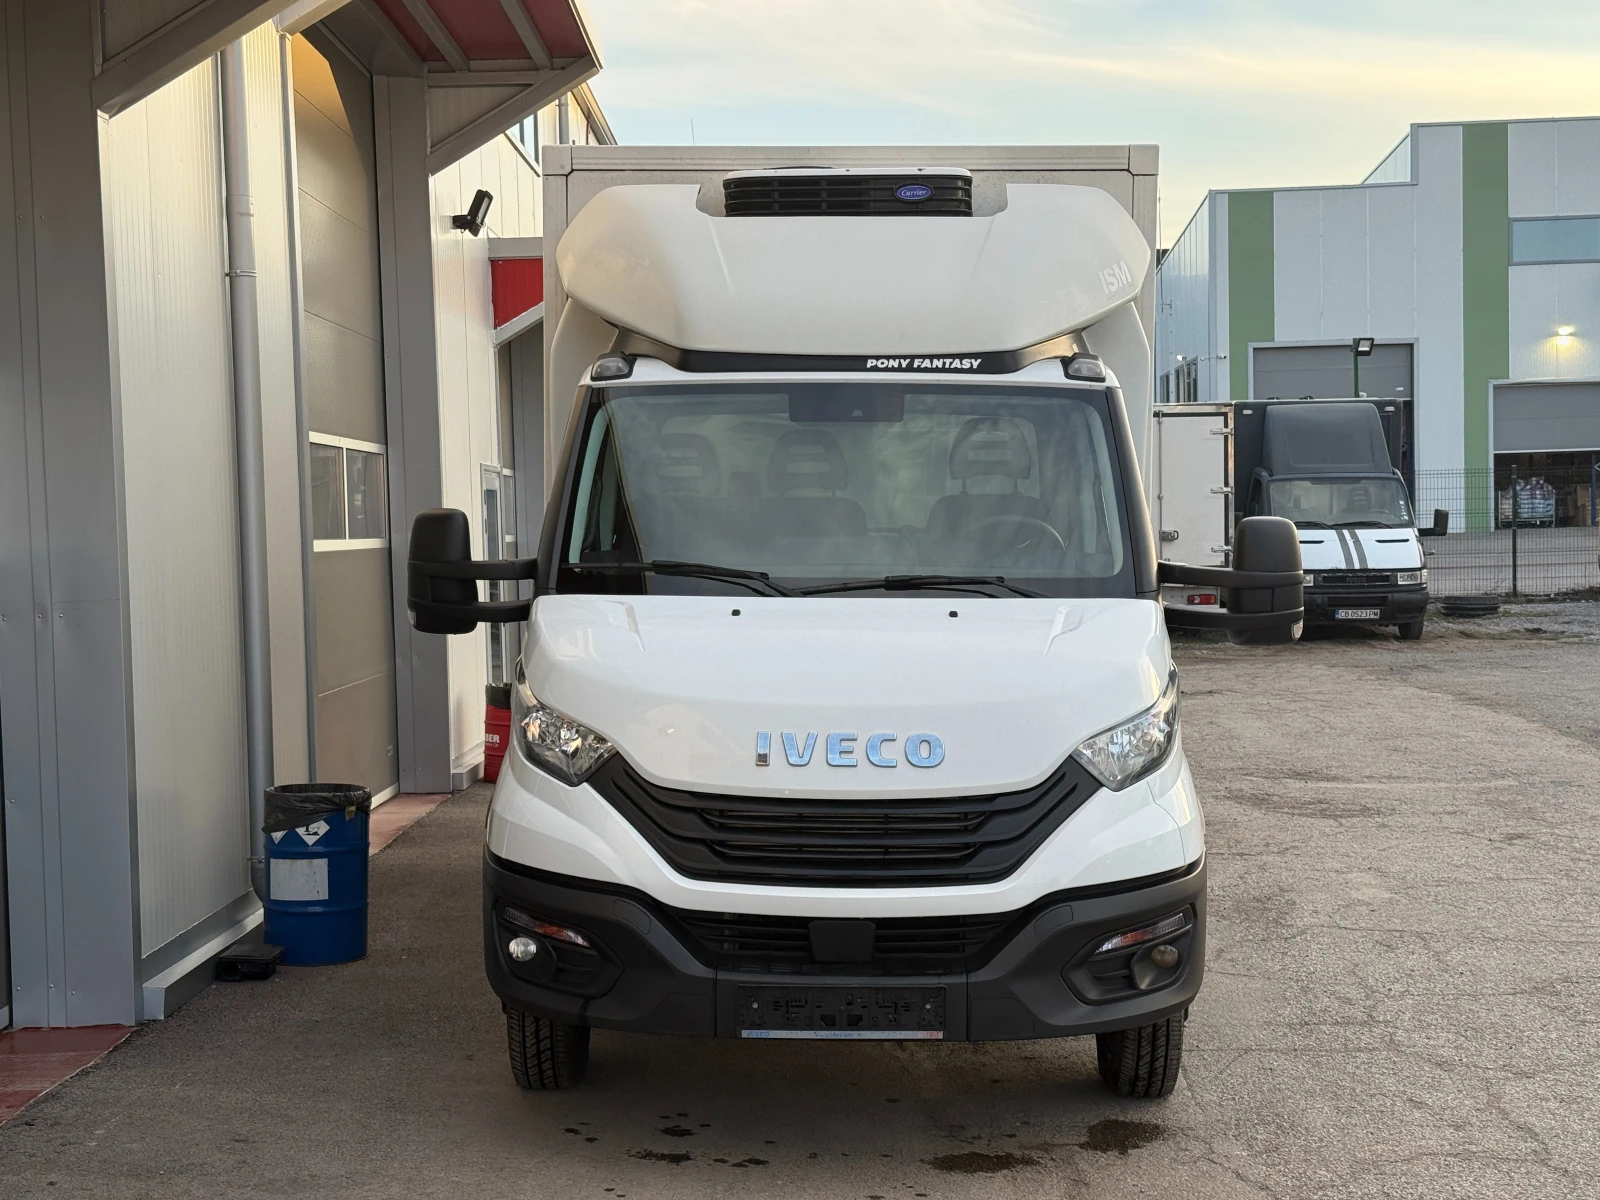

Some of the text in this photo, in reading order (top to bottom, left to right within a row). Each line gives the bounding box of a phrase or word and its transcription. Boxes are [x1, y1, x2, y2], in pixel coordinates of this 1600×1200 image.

[901, 189, 927, 197] Carrier
[1098, 259, 1132, 295] ISM
[866, 358, 982, 369] PONY FANTASY
[755, 731, 946, 768] IVECO
